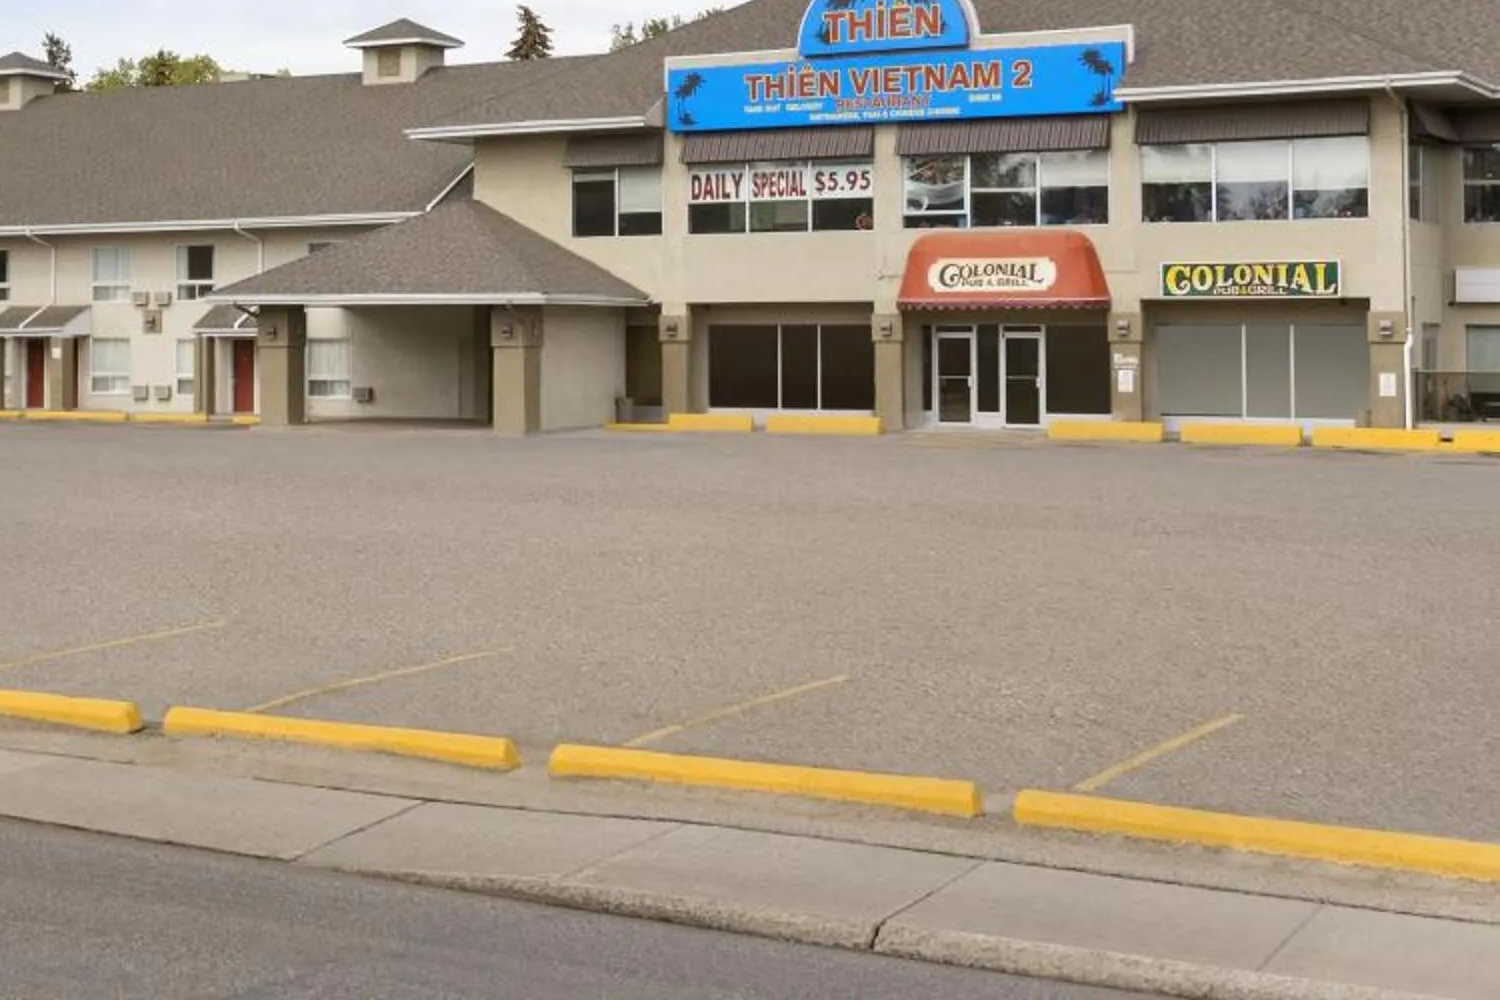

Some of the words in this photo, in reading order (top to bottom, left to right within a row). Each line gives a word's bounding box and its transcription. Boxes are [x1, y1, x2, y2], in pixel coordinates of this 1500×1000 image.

[848, 60, 1002, 96] VIETNAM
[1011, 59, 1033, 88] 2
[691, 172, 743, 201] DAILY
[752, 170, 806, 198] SPECIAL
[815, 170, 871, 193] $5.95
[939, 263, 1044, 288] COLONIAL
[1165, 263, 1338, 296] COLONIAL
